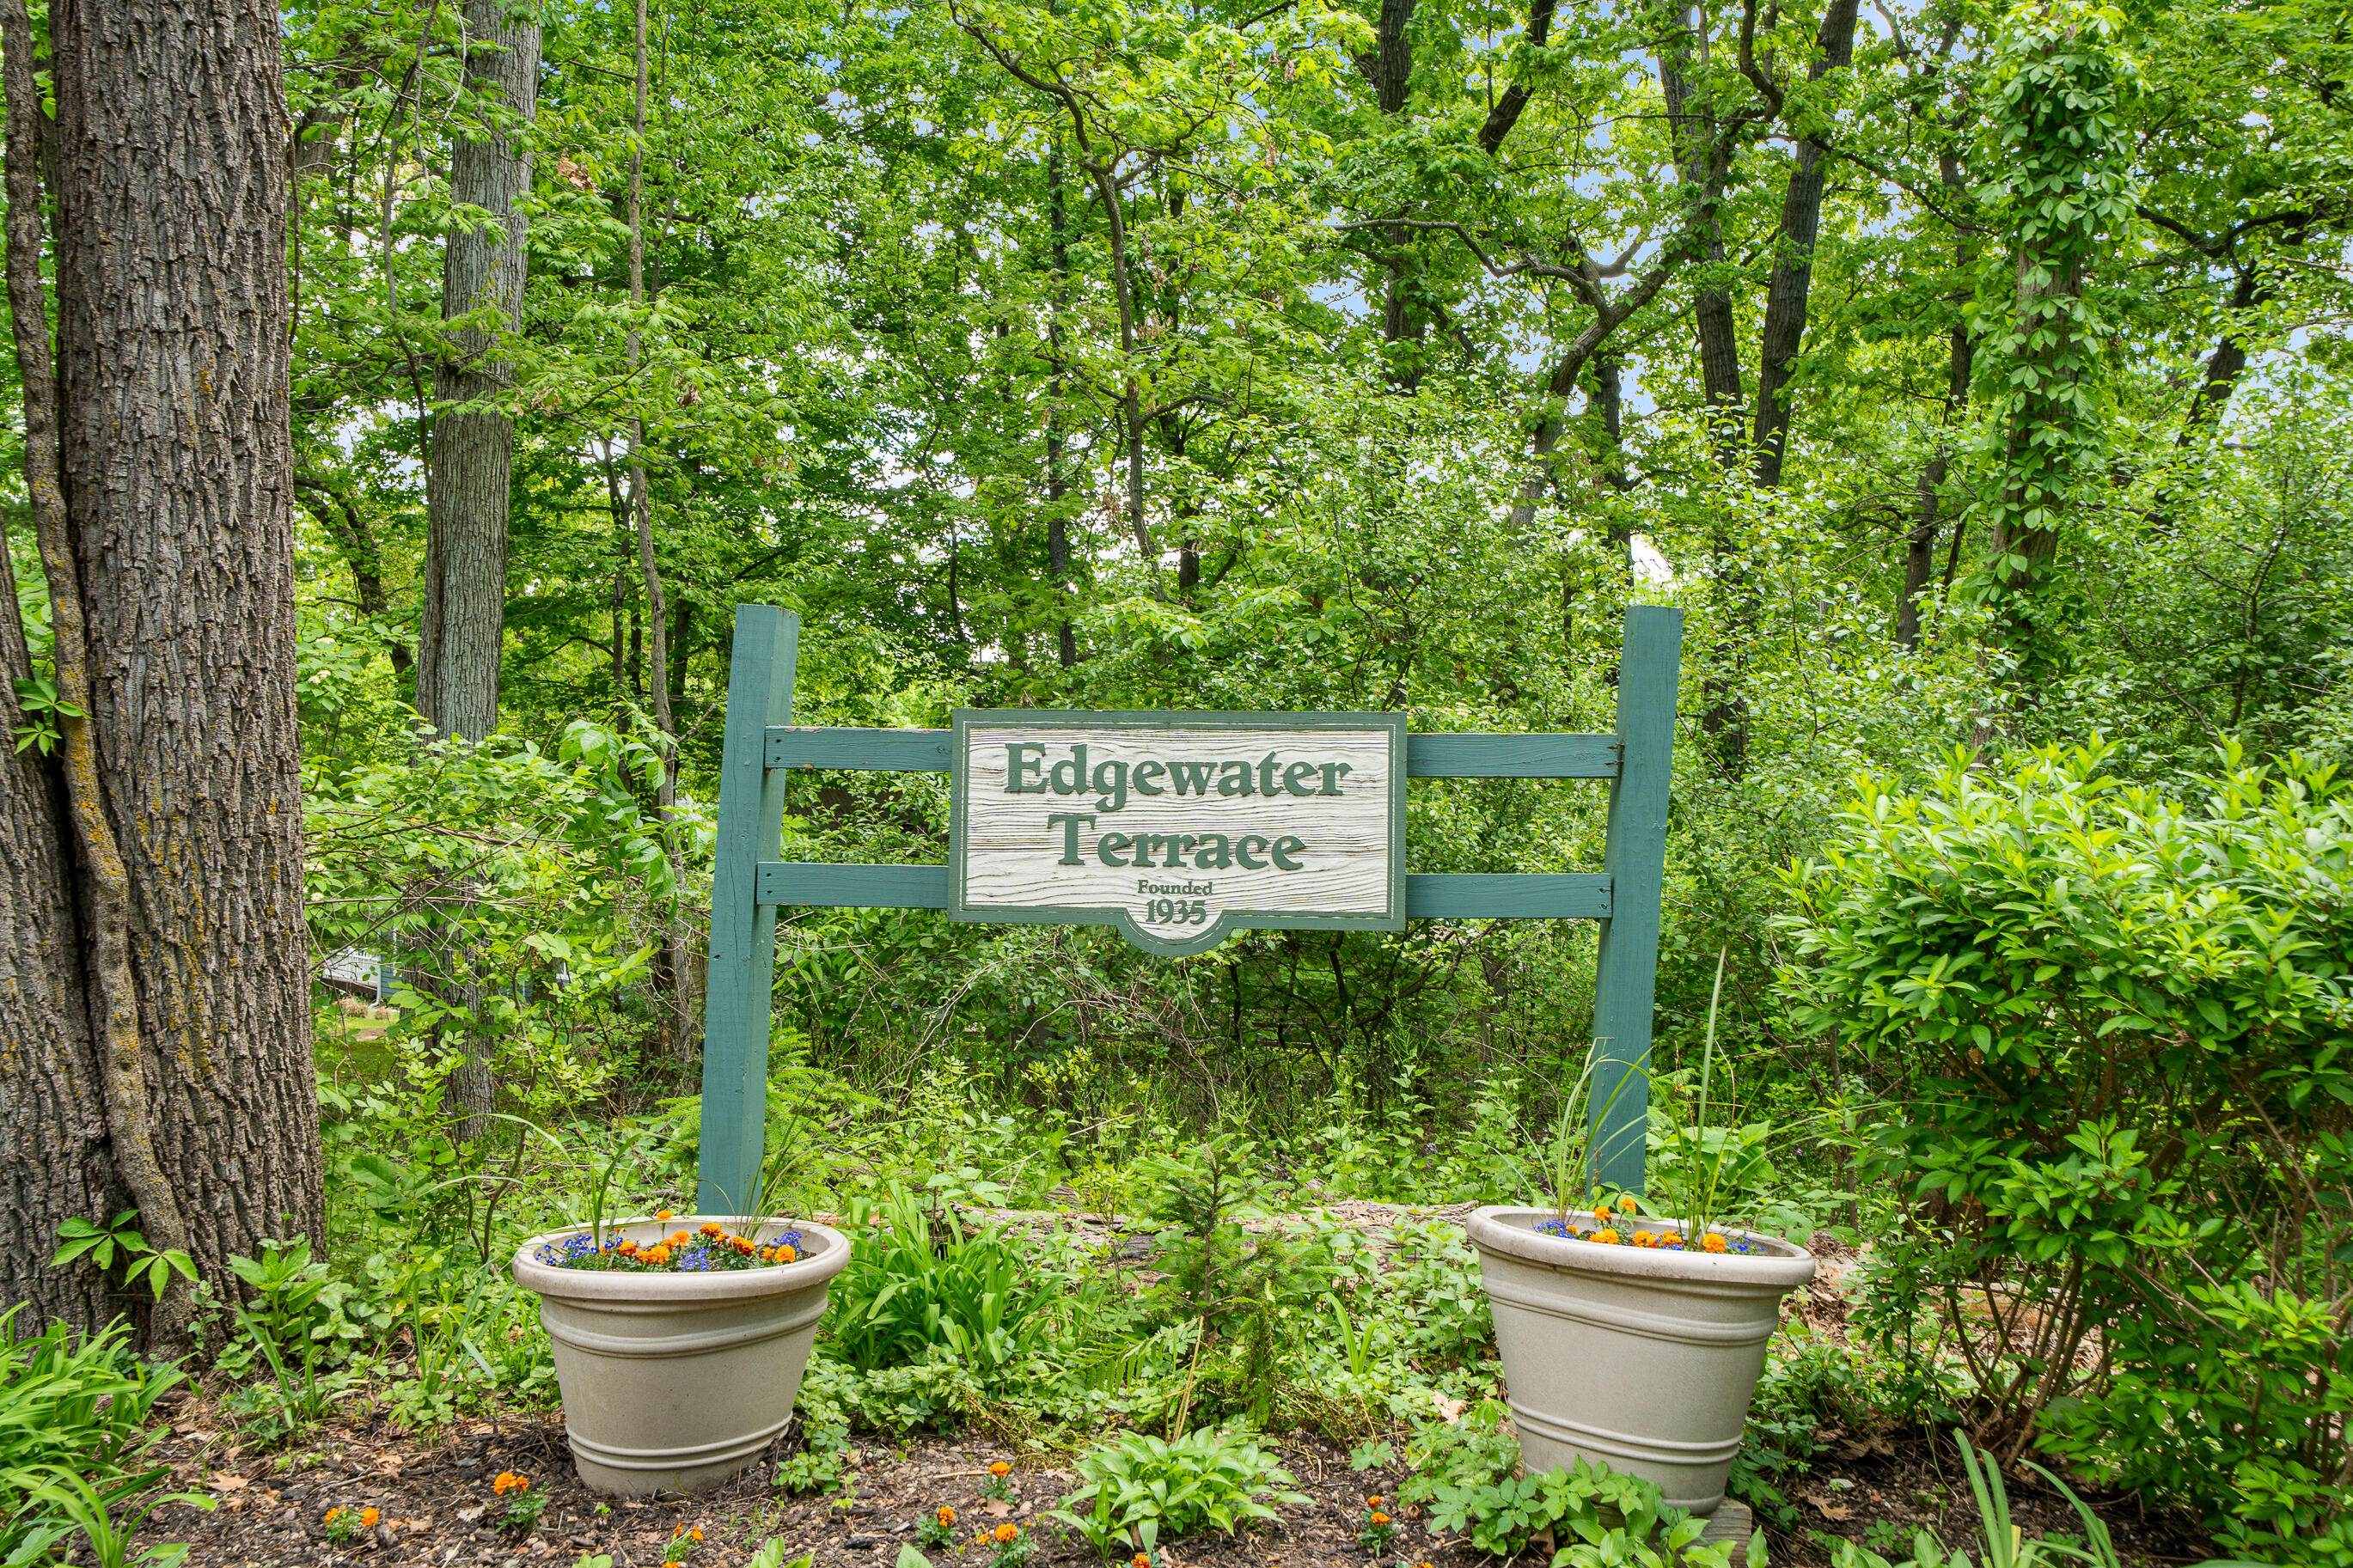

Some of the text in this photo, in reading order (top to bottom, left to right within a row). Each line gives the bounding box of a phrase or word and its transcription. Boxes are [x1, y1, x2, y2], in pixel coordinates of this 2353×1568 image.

[1004, 742, 1353, 812] Edgewater
[1047, 814, 1306, 870] Terrace
[1137, 879, 1213, 895] Founded
[1145, 898, 1207, 925] 1935
